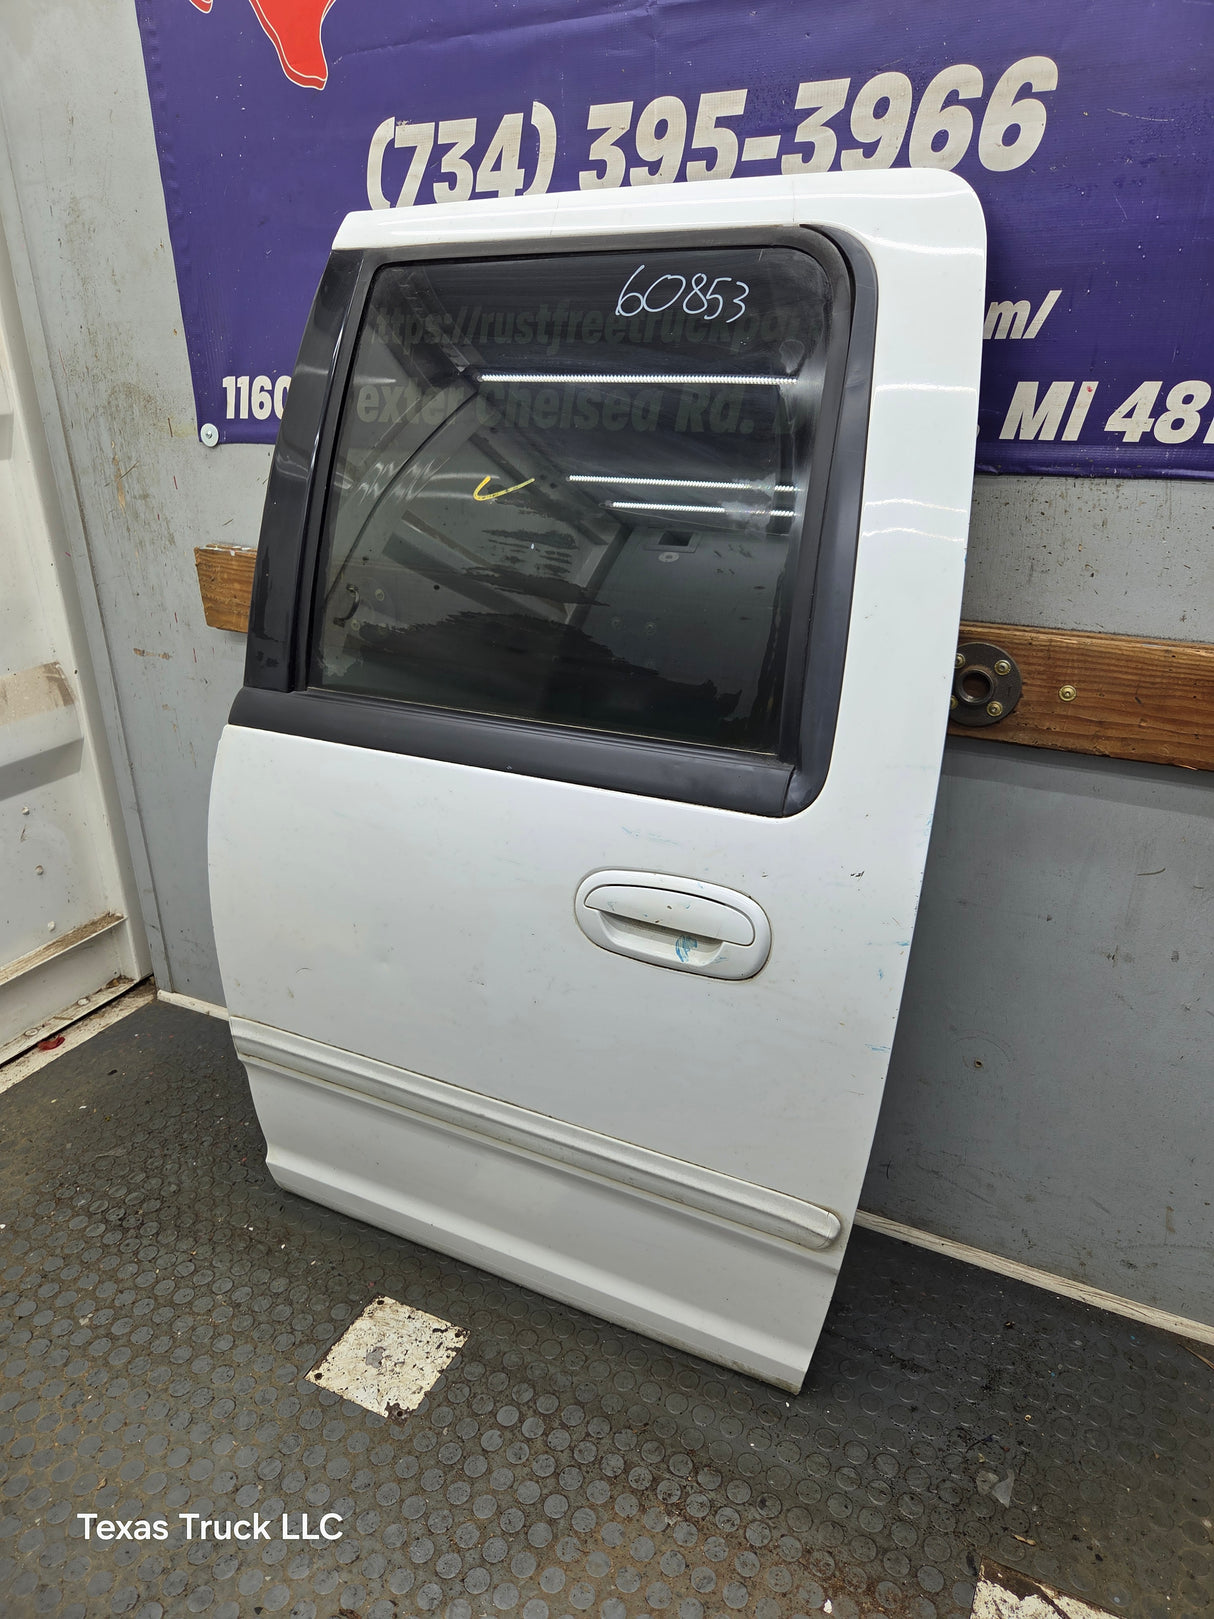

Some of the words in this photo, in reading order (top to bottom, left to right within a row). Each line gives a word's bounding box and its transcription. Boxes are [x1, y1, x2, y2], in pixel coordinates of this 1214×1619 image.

[366, 101, 558, 210] (734)
[578, 56, 1059, 189] 395-3966
[615, 264, 750, 324] 60853
[357, 378, 465, 425] exter
[674, 382, 755, 433] Rd.
[998, 381, 1099, 441] MI
[1103, 380, 1214, 444] 48
